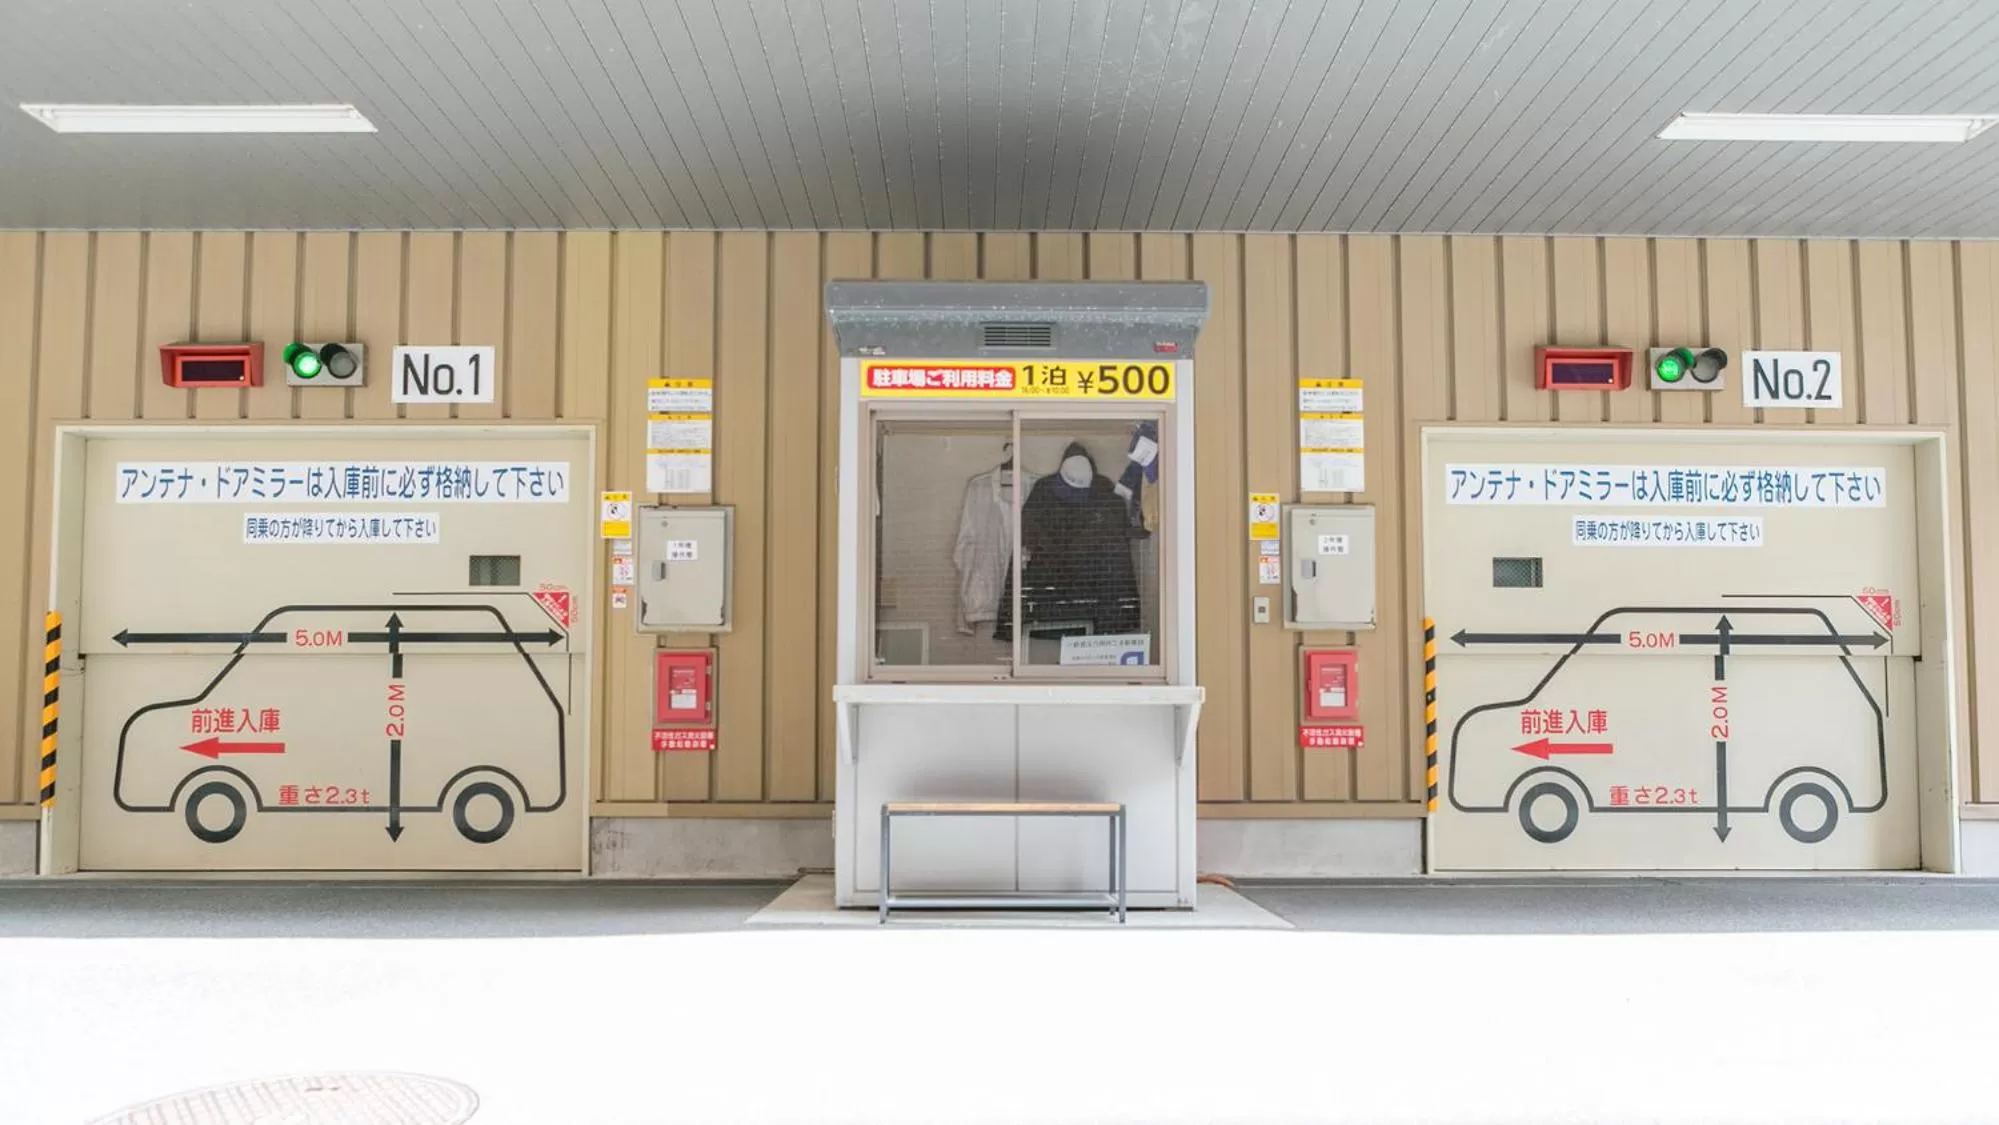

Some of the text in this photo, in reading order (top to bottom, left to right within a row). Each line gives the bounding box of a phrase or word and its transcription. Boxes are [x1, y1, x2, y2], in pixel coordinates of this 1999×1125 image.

[402, 353, 480, 396] No.1
[873, 367, 1013, 388] 駐車場ご利用料金
[1077, 364, 1170, 395] ¥500
[1753, 358, 1832, 401] No.2
[120, 465, 566, 500] アンテナ・ドアミラーは入庫前に必ず格納して下さい
[1449, 468, 1882, 504] アンテナ・ドアミラーは入庫前に必ず格納して下さい
[245, 516, 438, 541] 同乗の方が降りてから入庫して下さい
[1574, 519, 1762, 544] 同乗の方が降りてから入庫して下さい
[294, 628, 344, 648] 5.0M
[1627, 631, 1675, 649] 5.0M
[190, 706, 281, 735] 前進入庫
[384, 682, 406, 738] 2.0M
[1520, 708, 1609, 735] 前進入庫
[1710, 686, 1730, 740] 2.0M
